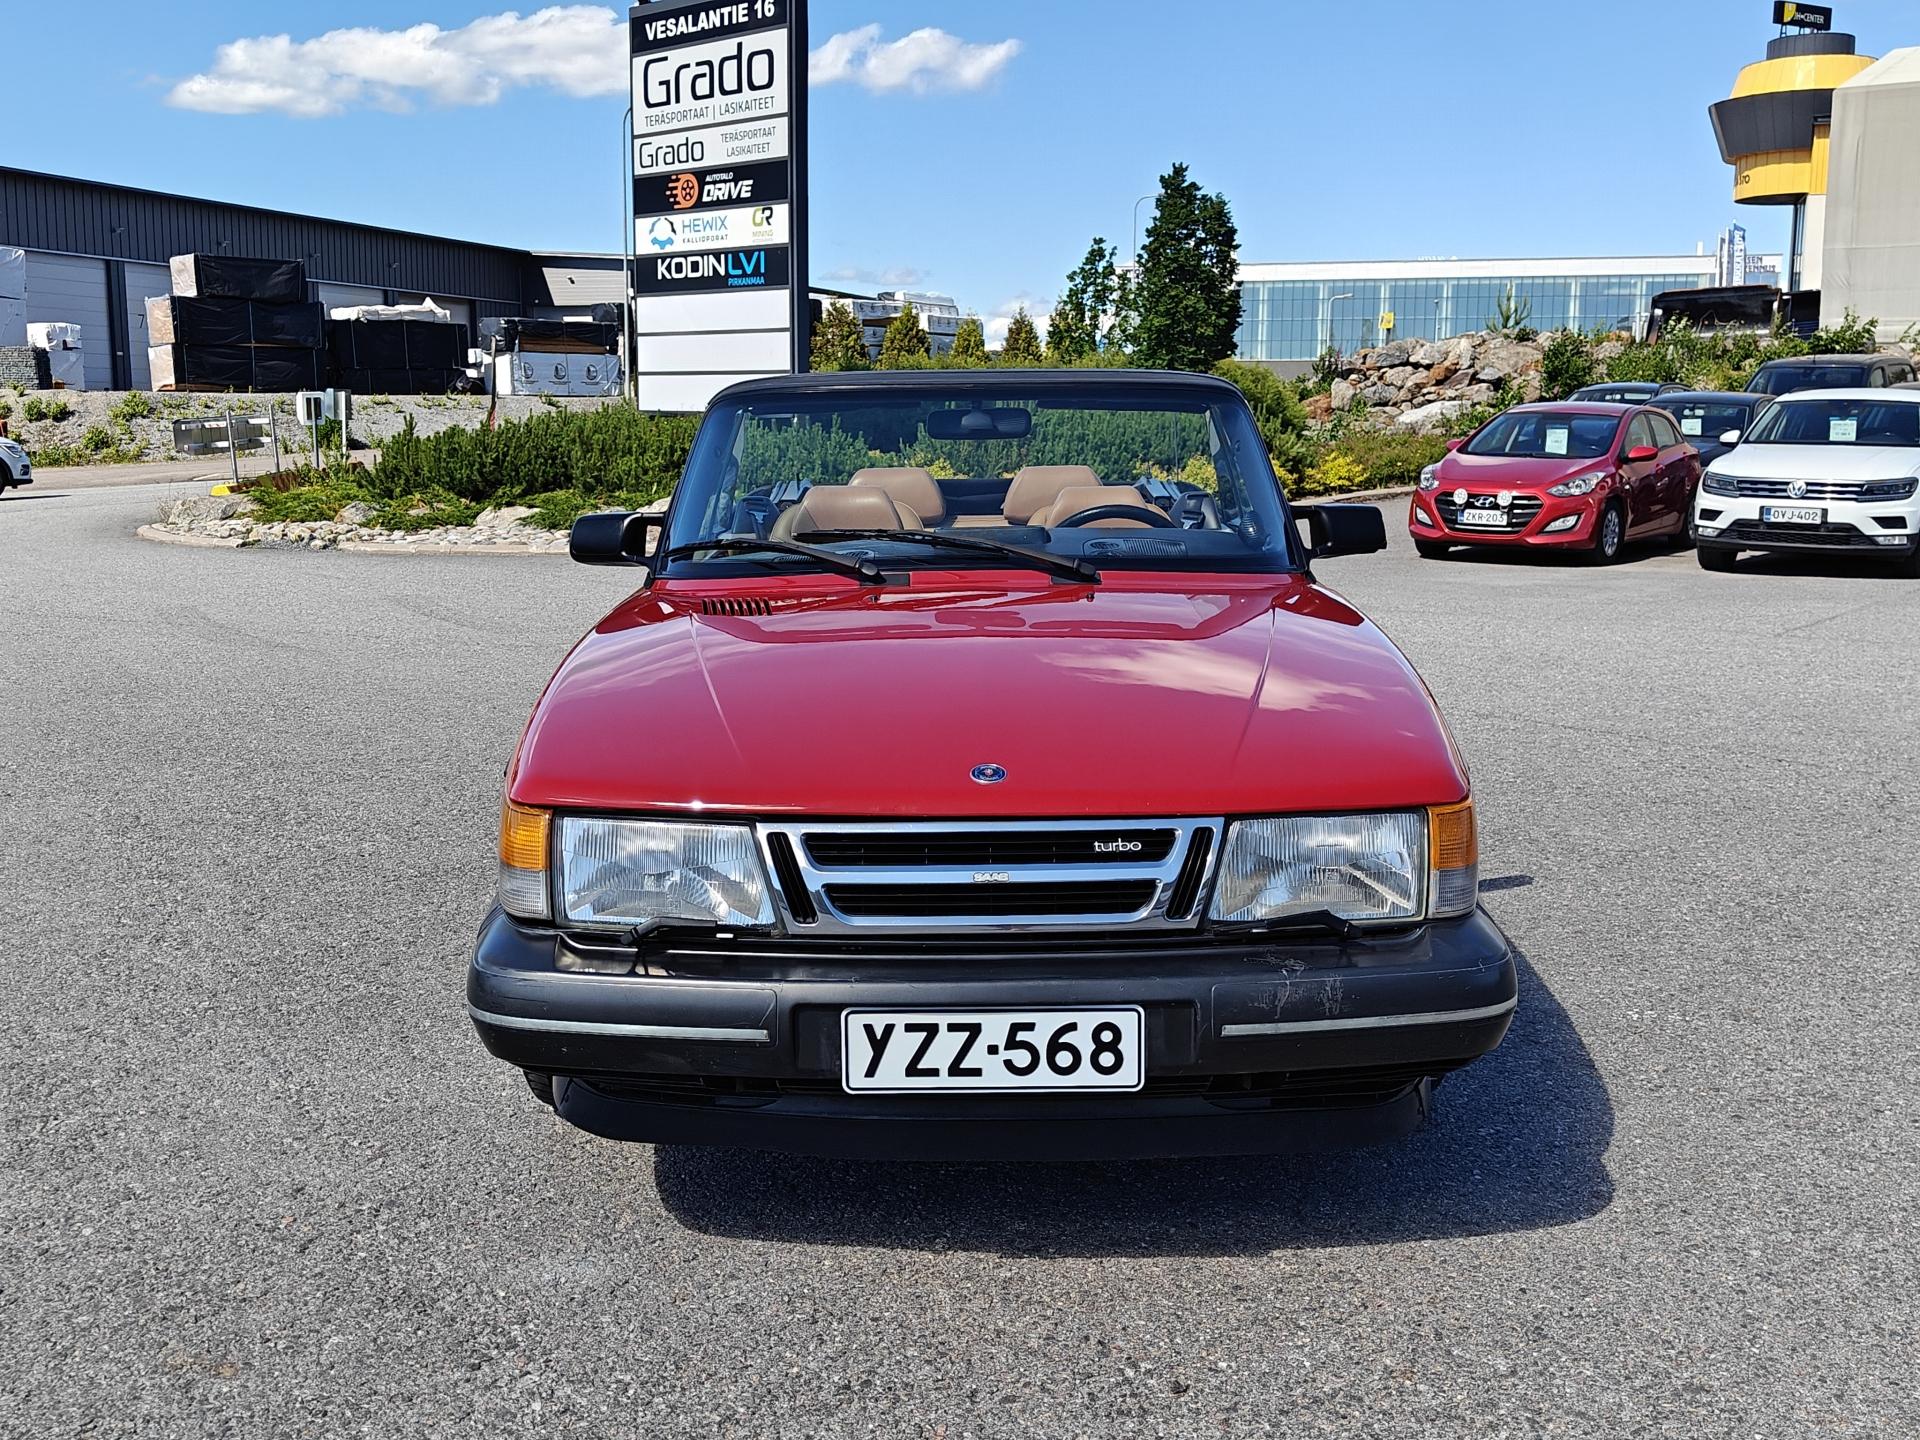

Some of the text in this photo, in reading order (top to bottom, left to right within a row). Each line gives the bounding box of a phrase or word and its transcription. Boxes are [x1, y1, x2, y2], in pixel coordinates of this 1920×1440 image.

[645, 0, 775, 41] VESALANTIE 16
[643, 42, 775, 109] Grado
[645, 96, 775, 127] TERÄSPORTAAT LASIKAITEET
[720, 126, 776, 143] TERÄSPORTAAT
[639, 136, 704, 169] Grado
[726, 142, 770, 158] LASIKAITEET
[705, 172, 733, 182] AUTOTALO
[702, 179, 753, 202] DRIVE
[682, 215, 728, 234] HEWIX
[728, 276, 765, 287] PIRKANMAA
[138, 313, 145, 329] 7
[1465, 511, 1505, 523] ZKR-203
[1772, 510, 1818, 522] OVJ-402
[1093, 837, 1142, 852] turbo
[973, 872, 1009, 882] SAAB
[862, 1020, 1125, 1079] YZZ-568
